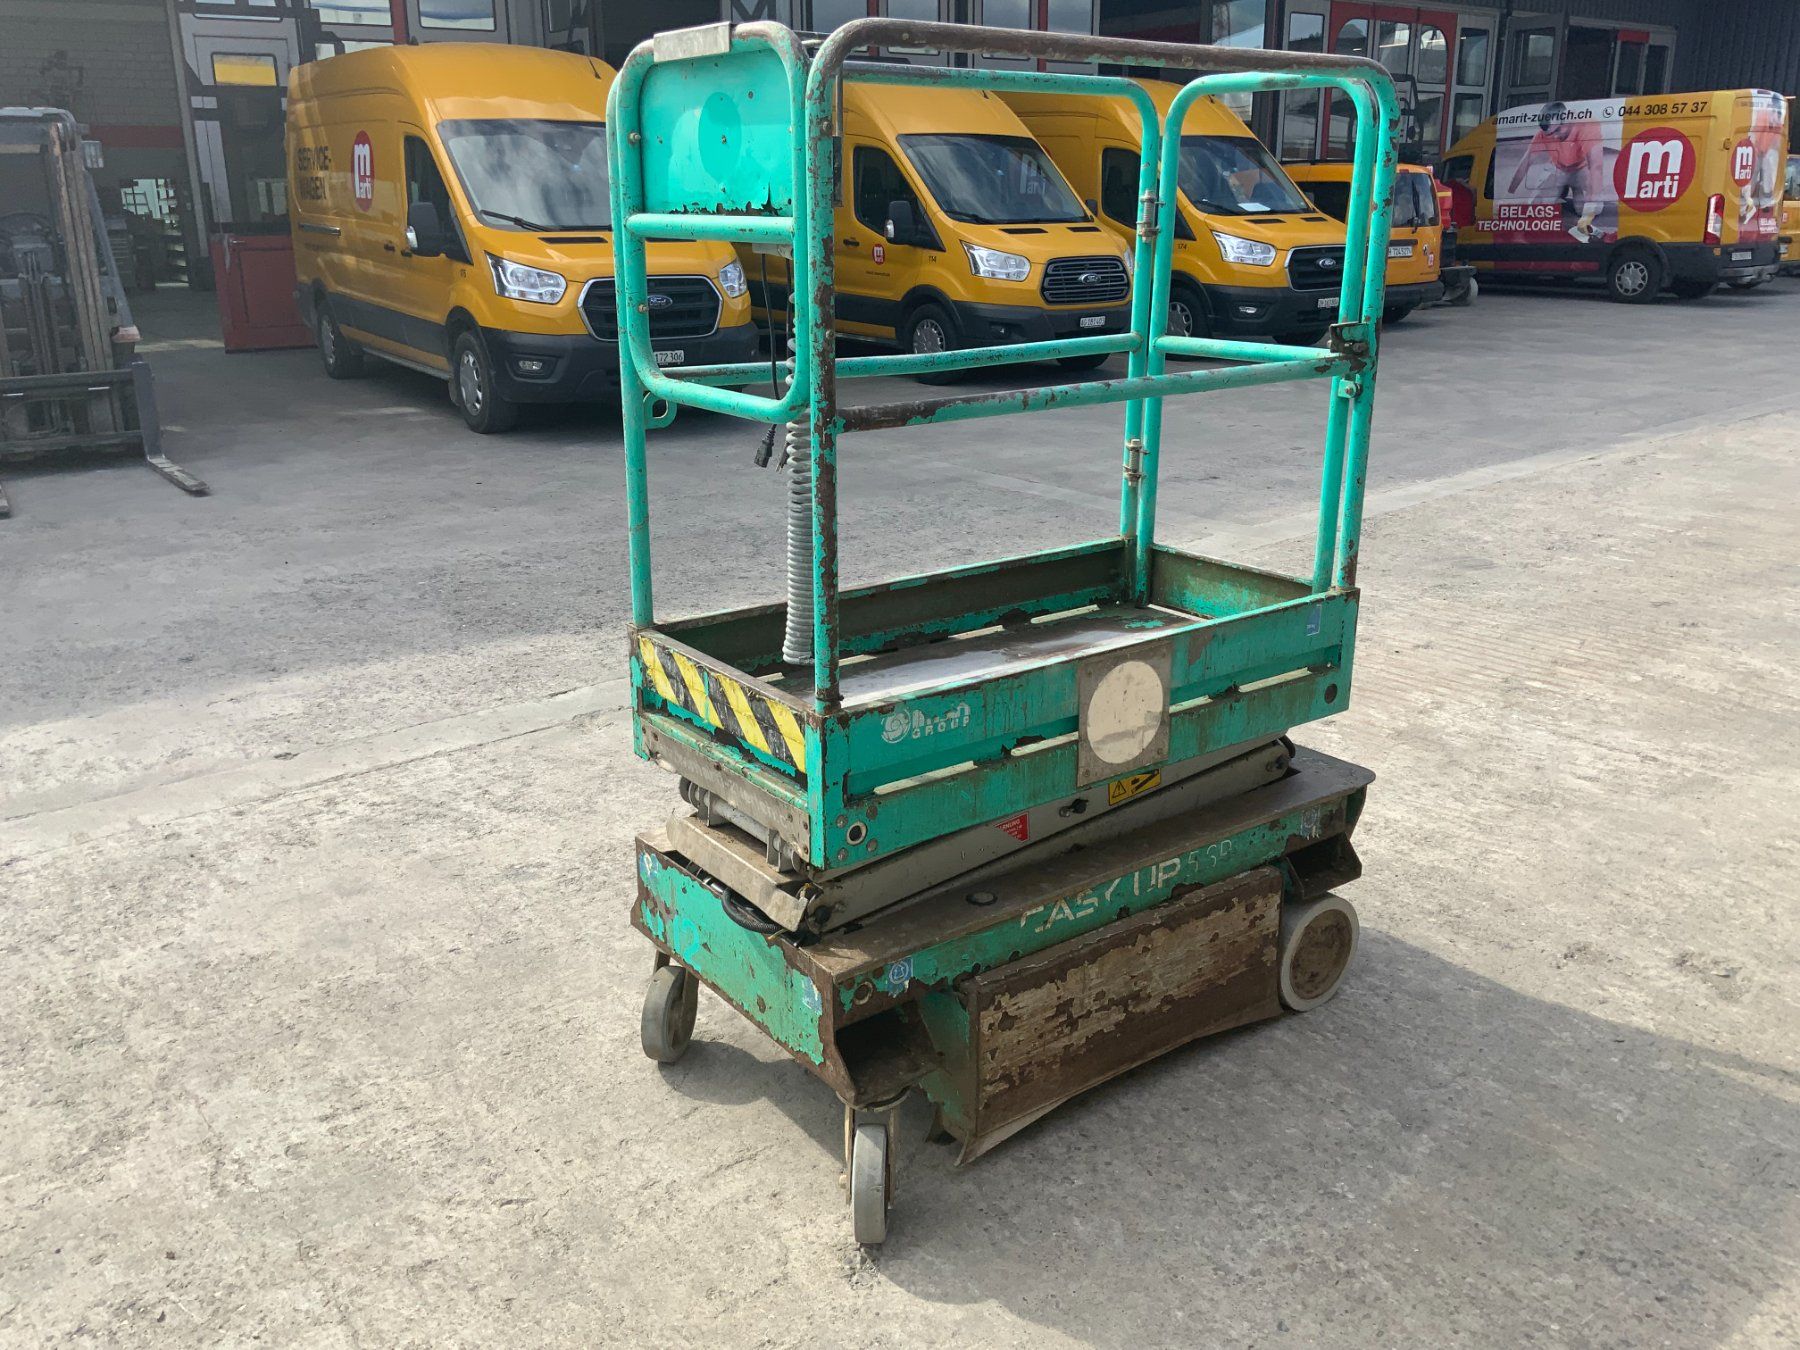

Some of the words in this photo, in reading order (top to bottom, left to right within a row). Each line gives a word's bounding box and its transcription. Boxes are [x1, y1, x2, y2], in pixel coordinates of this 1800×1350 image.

[1618, 105, 1644, 117] 044
[1644, 104, 1668, 115] 308
[1672, 103, 1688, 114] 57
[1690, 101, 1708, 113] 37
[1624, 139, 1684, 199] marti
[1500, 205, 1560, 218] BELAGS-
[1477, 220, 1562, 231] TECHNOLOGIE
